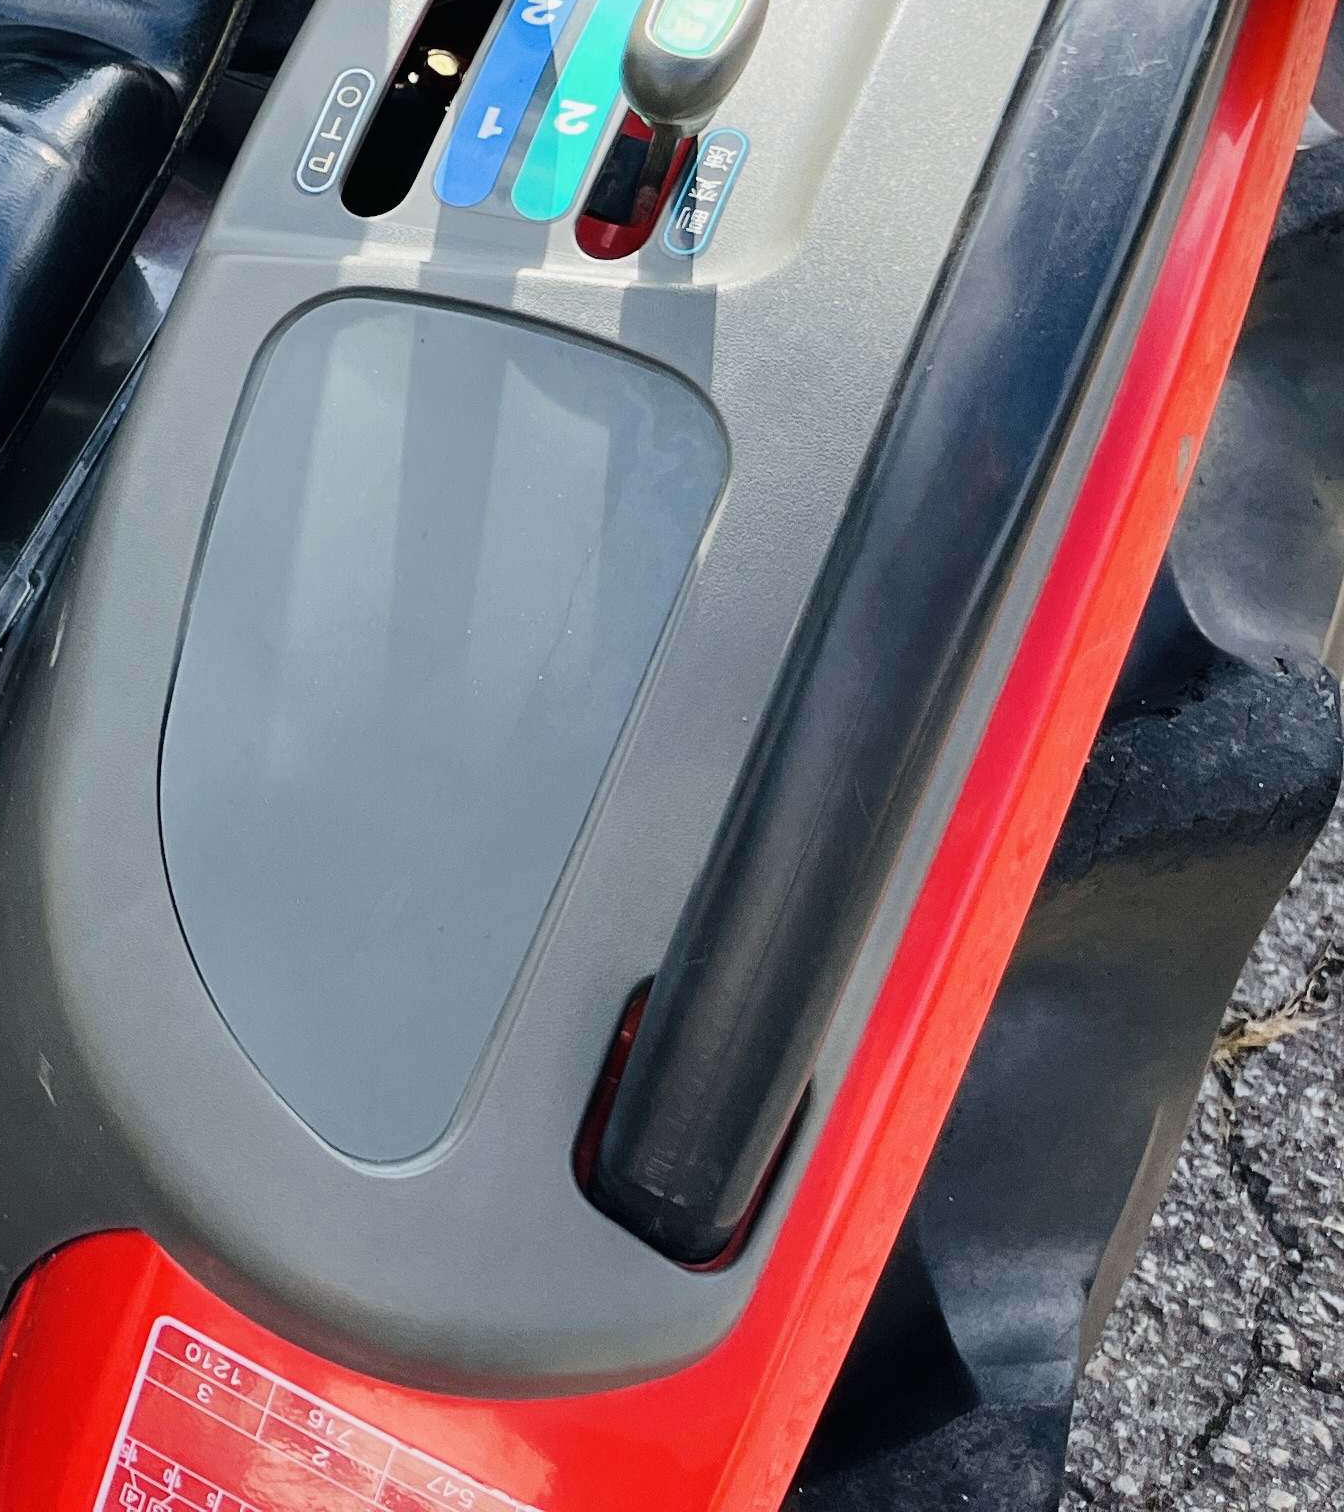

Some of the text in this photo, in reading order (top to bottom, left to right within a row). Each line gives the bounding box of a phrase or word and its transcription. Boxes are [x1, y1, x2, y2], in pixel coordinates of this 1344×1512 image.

[307, 85, 363, 174] PTO
[477, 104, 504, 140] 1
[553, 99, 597, 135] 2
[674, 145, 737, 235] 副変速
[184, 1341, 242, 1388] 1210
[196, 1383, 214, 1404] 3
[306, 1407, 354, 1447] 716
[310, 1443, 332, 1468] 2
[426, 1474, 476, 1509] 547
